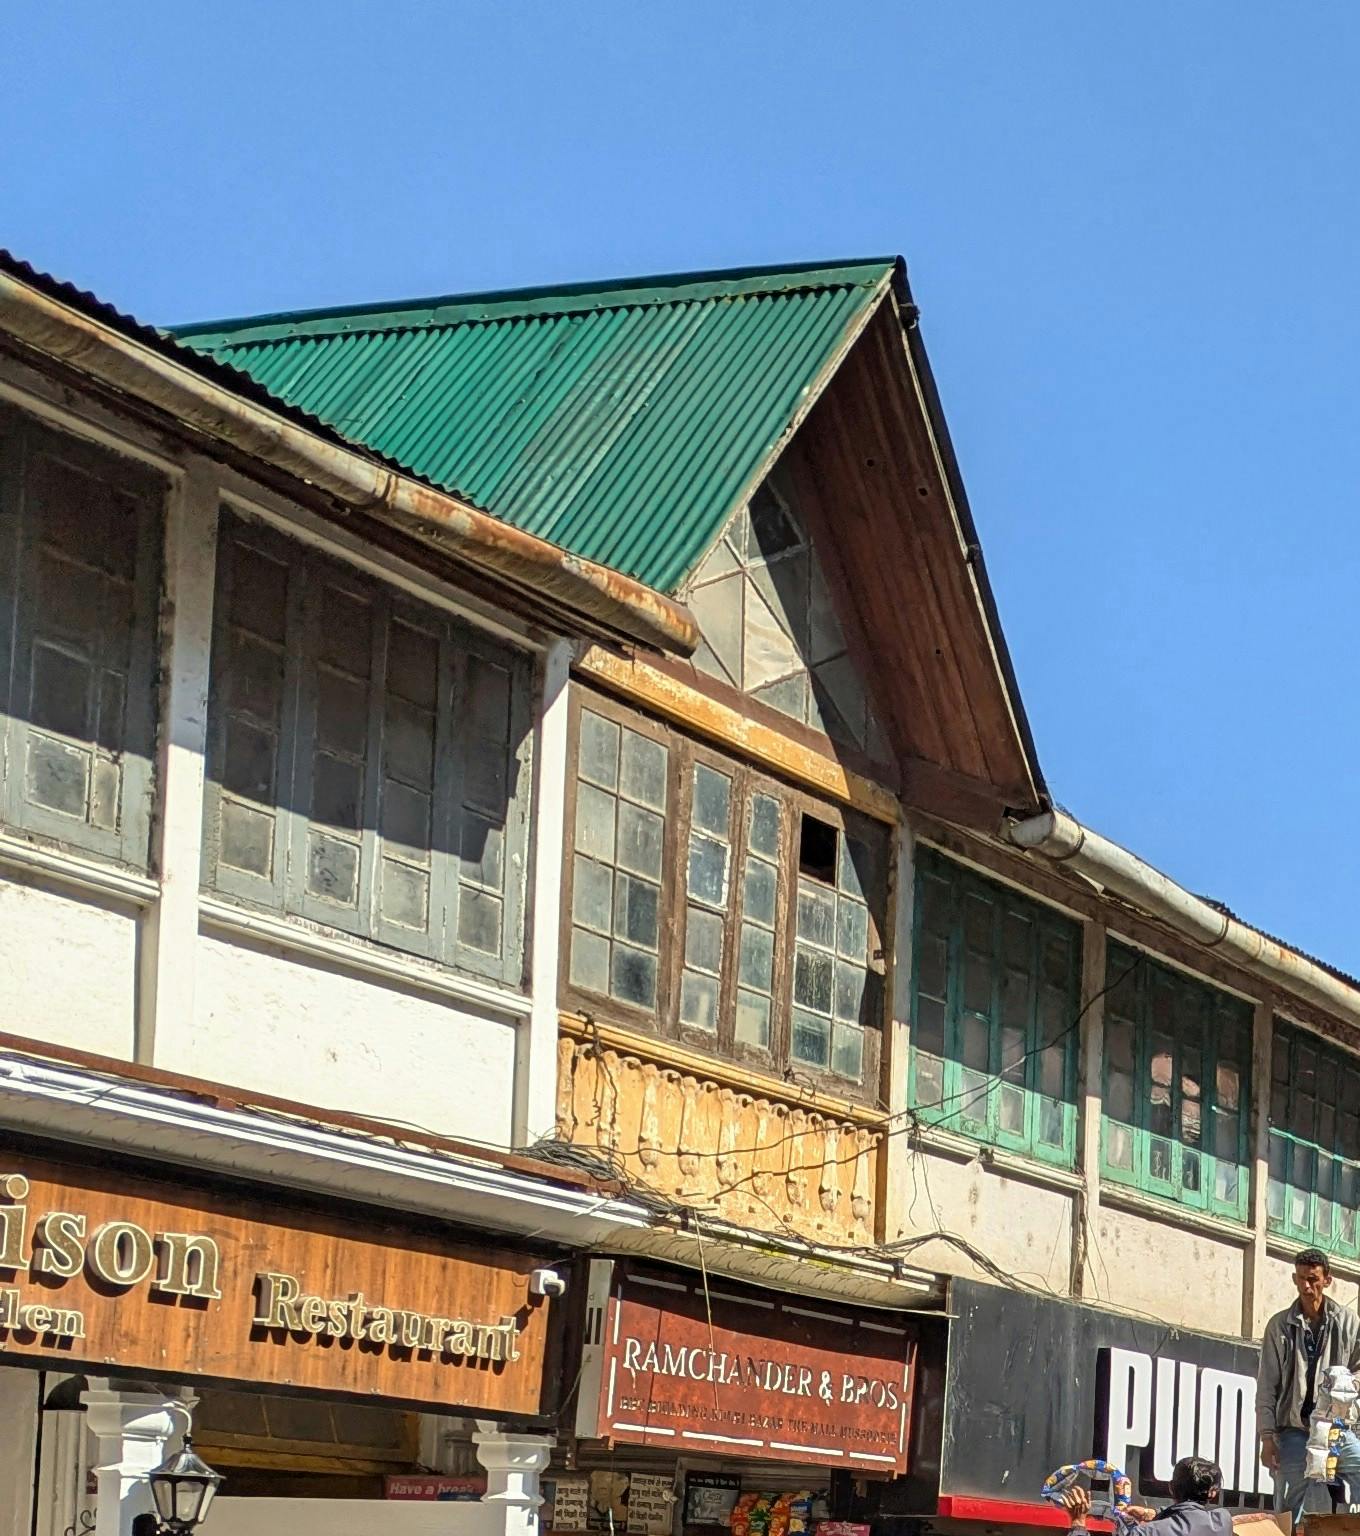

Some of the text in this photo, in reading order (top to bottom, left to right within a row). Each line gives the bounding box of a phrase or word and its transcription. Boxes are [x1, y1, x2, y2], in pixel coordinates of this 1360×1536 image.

[264, 1273, 520, 1361] Restaurant
[623, 1338, 899, 1410] RAMCHANDER & BROS
[1107, 1347, 1275, 1496] PUM
[389, 1482, 425, 1495] Have
